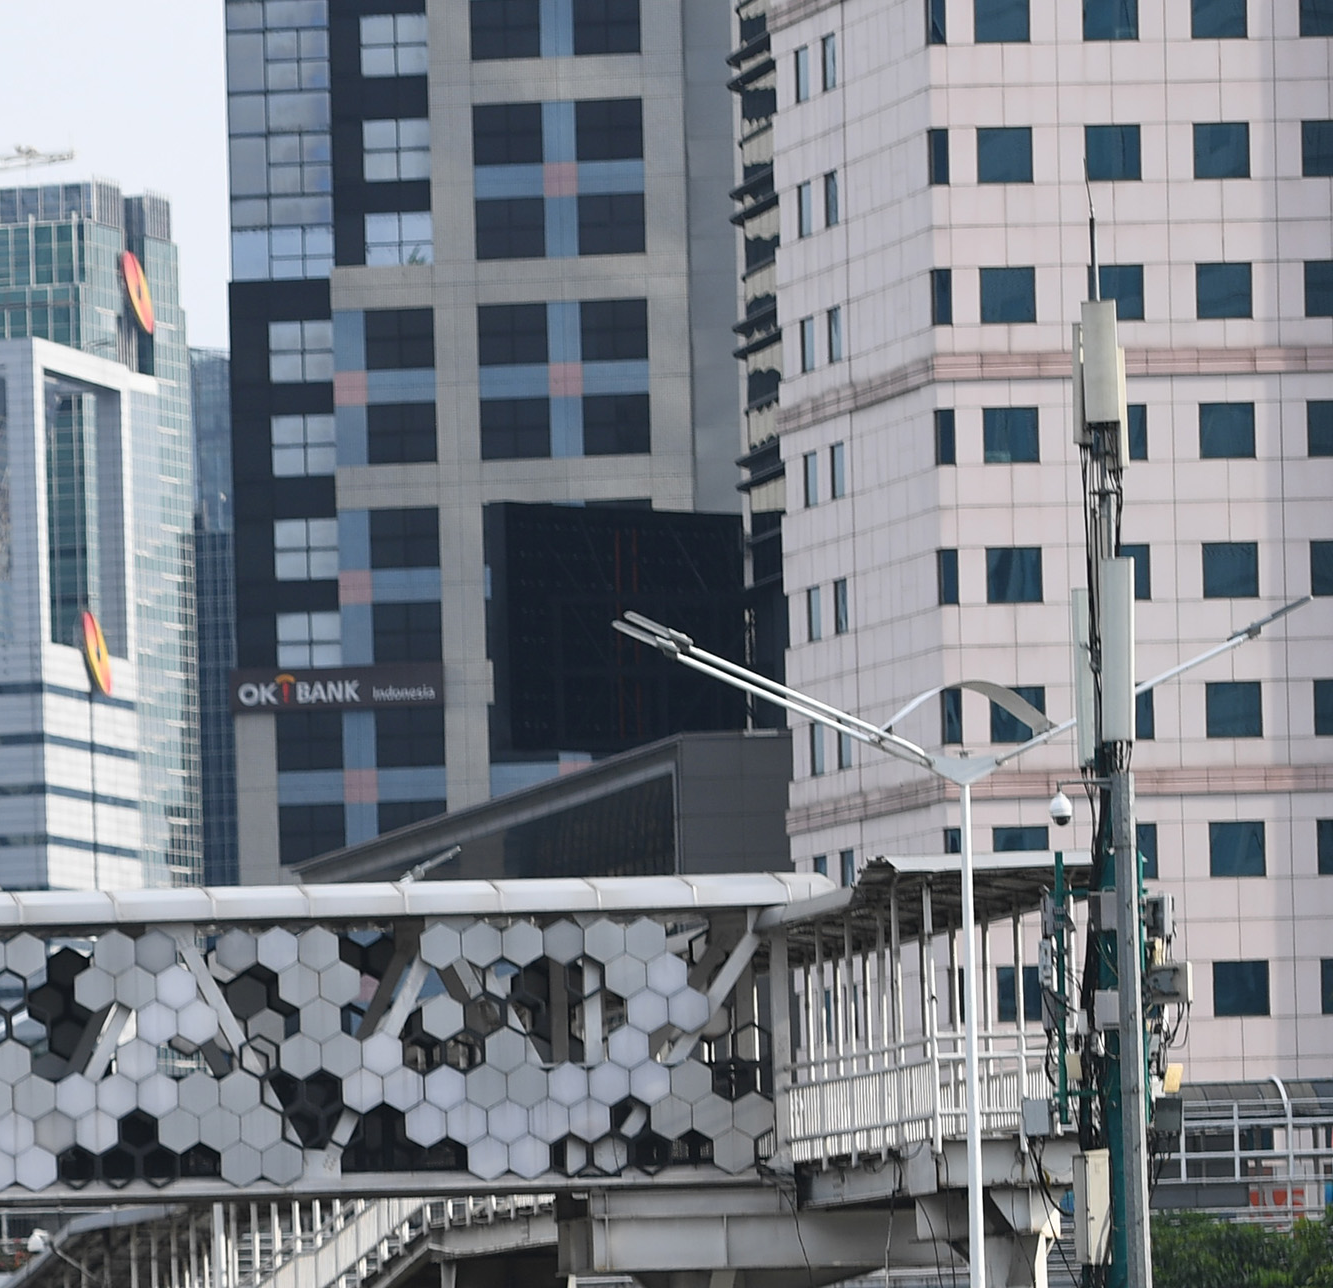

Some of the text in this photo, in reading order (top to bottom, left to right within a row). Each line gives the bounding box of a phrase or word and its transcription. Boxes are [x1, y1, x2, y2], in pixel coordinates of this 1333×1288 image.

[238, 680, 361, 706] OK BANK
[372, 683, 436, 701] Indonesia
